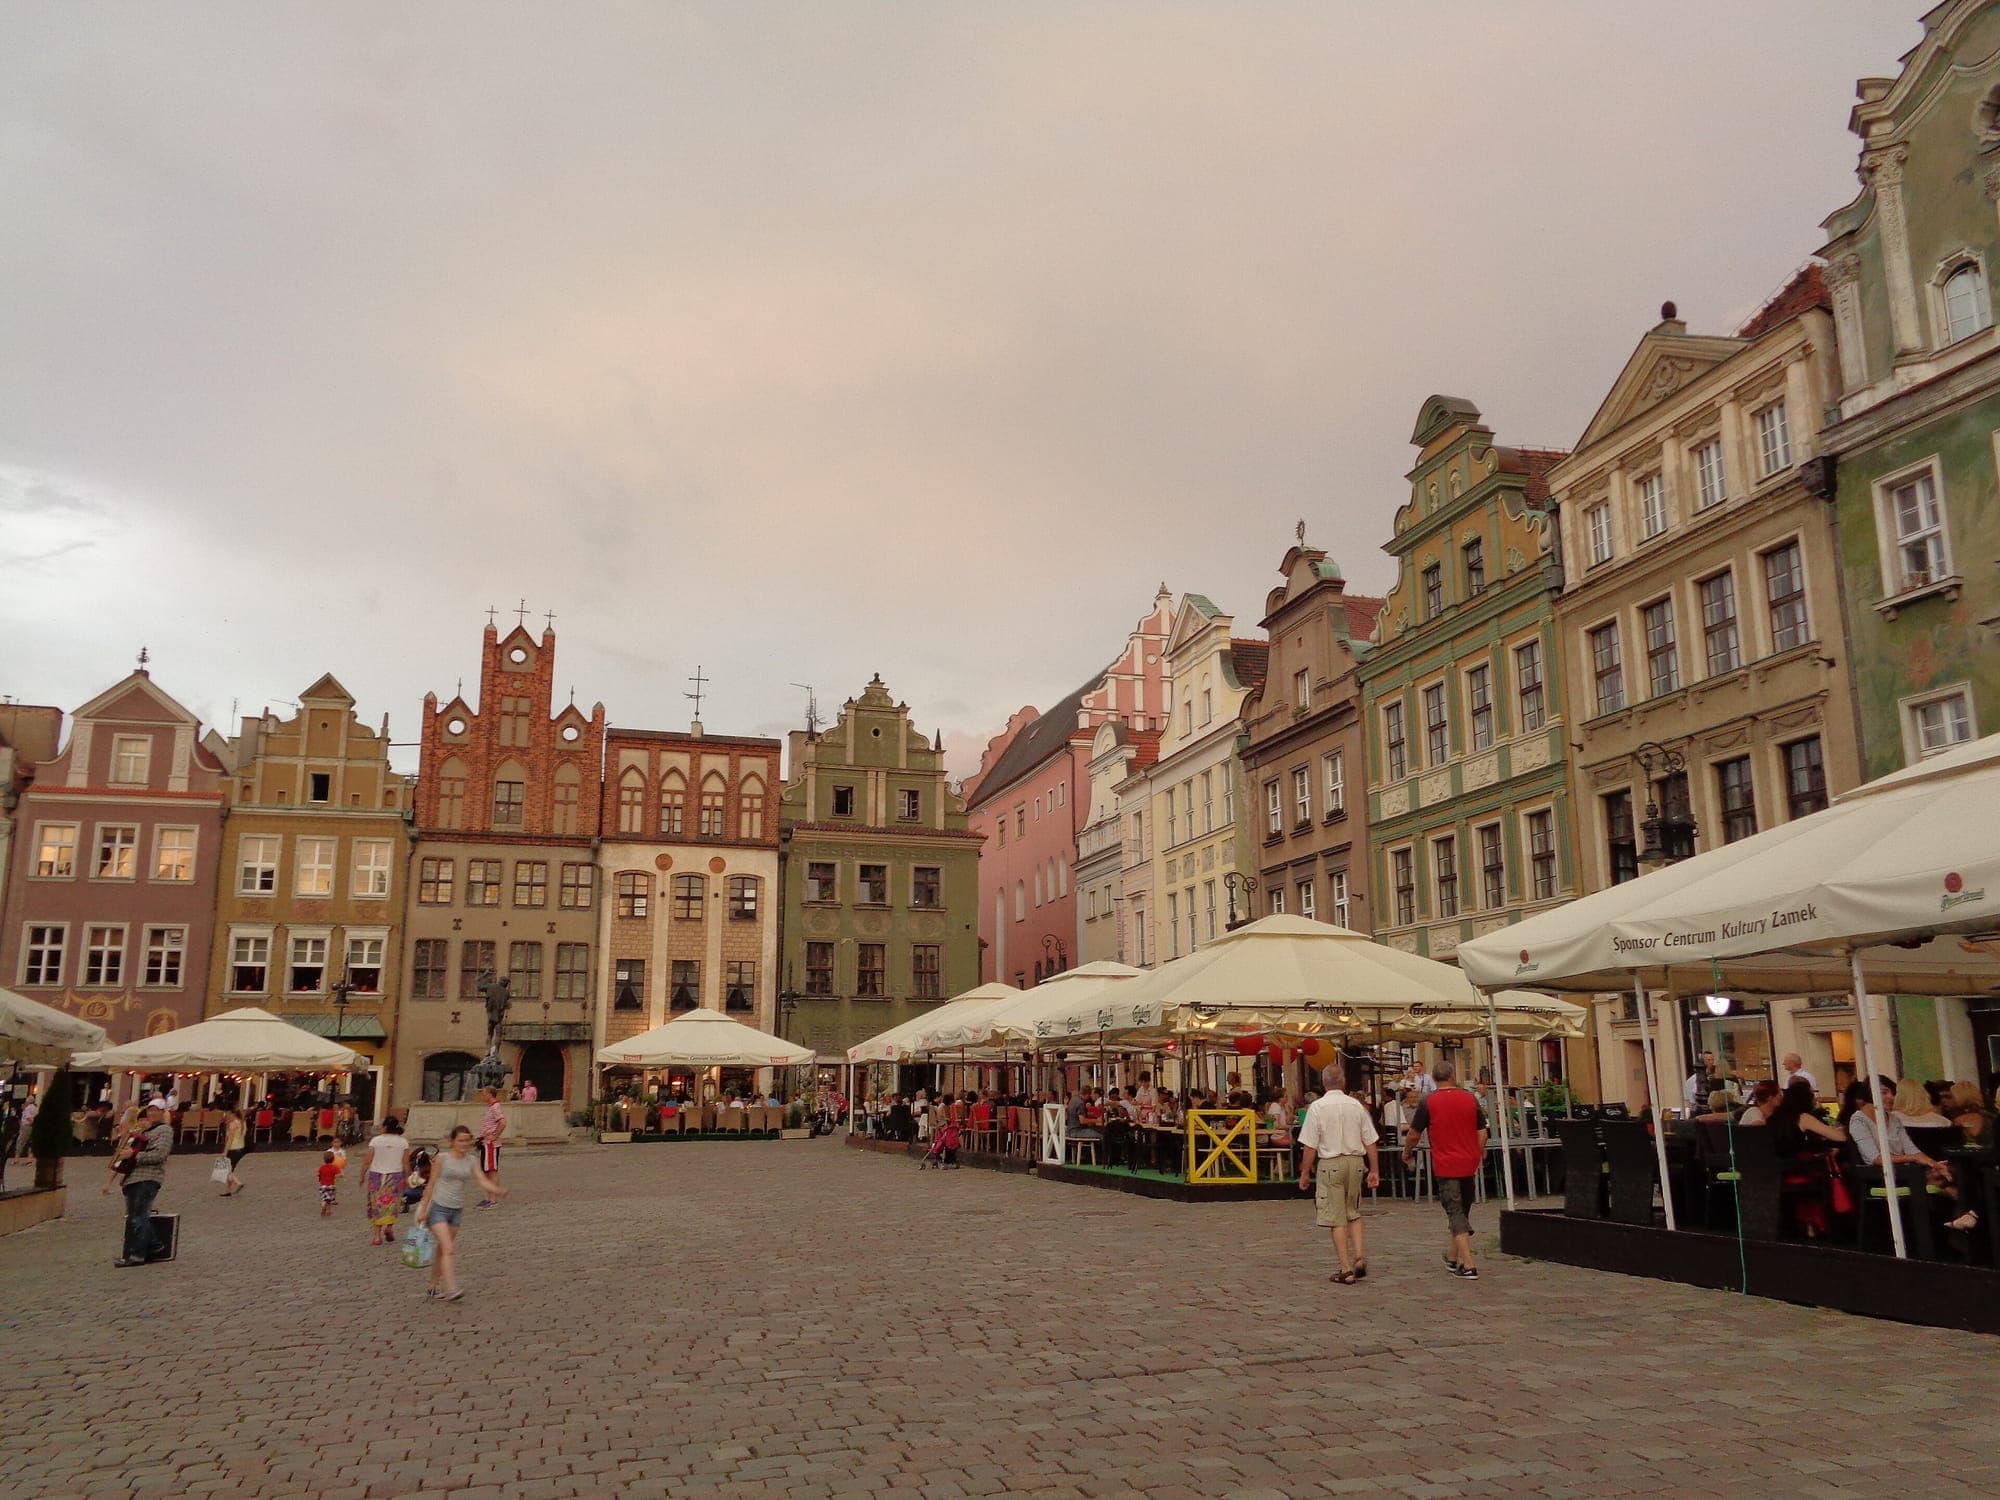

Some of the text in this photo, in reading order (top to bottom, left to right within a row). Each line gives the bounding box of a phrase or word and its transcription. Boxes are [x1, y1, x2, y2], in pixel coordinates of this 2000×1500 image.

[1613, 903, 1817, 953] Sponsor Centrum Kultury Zamek
